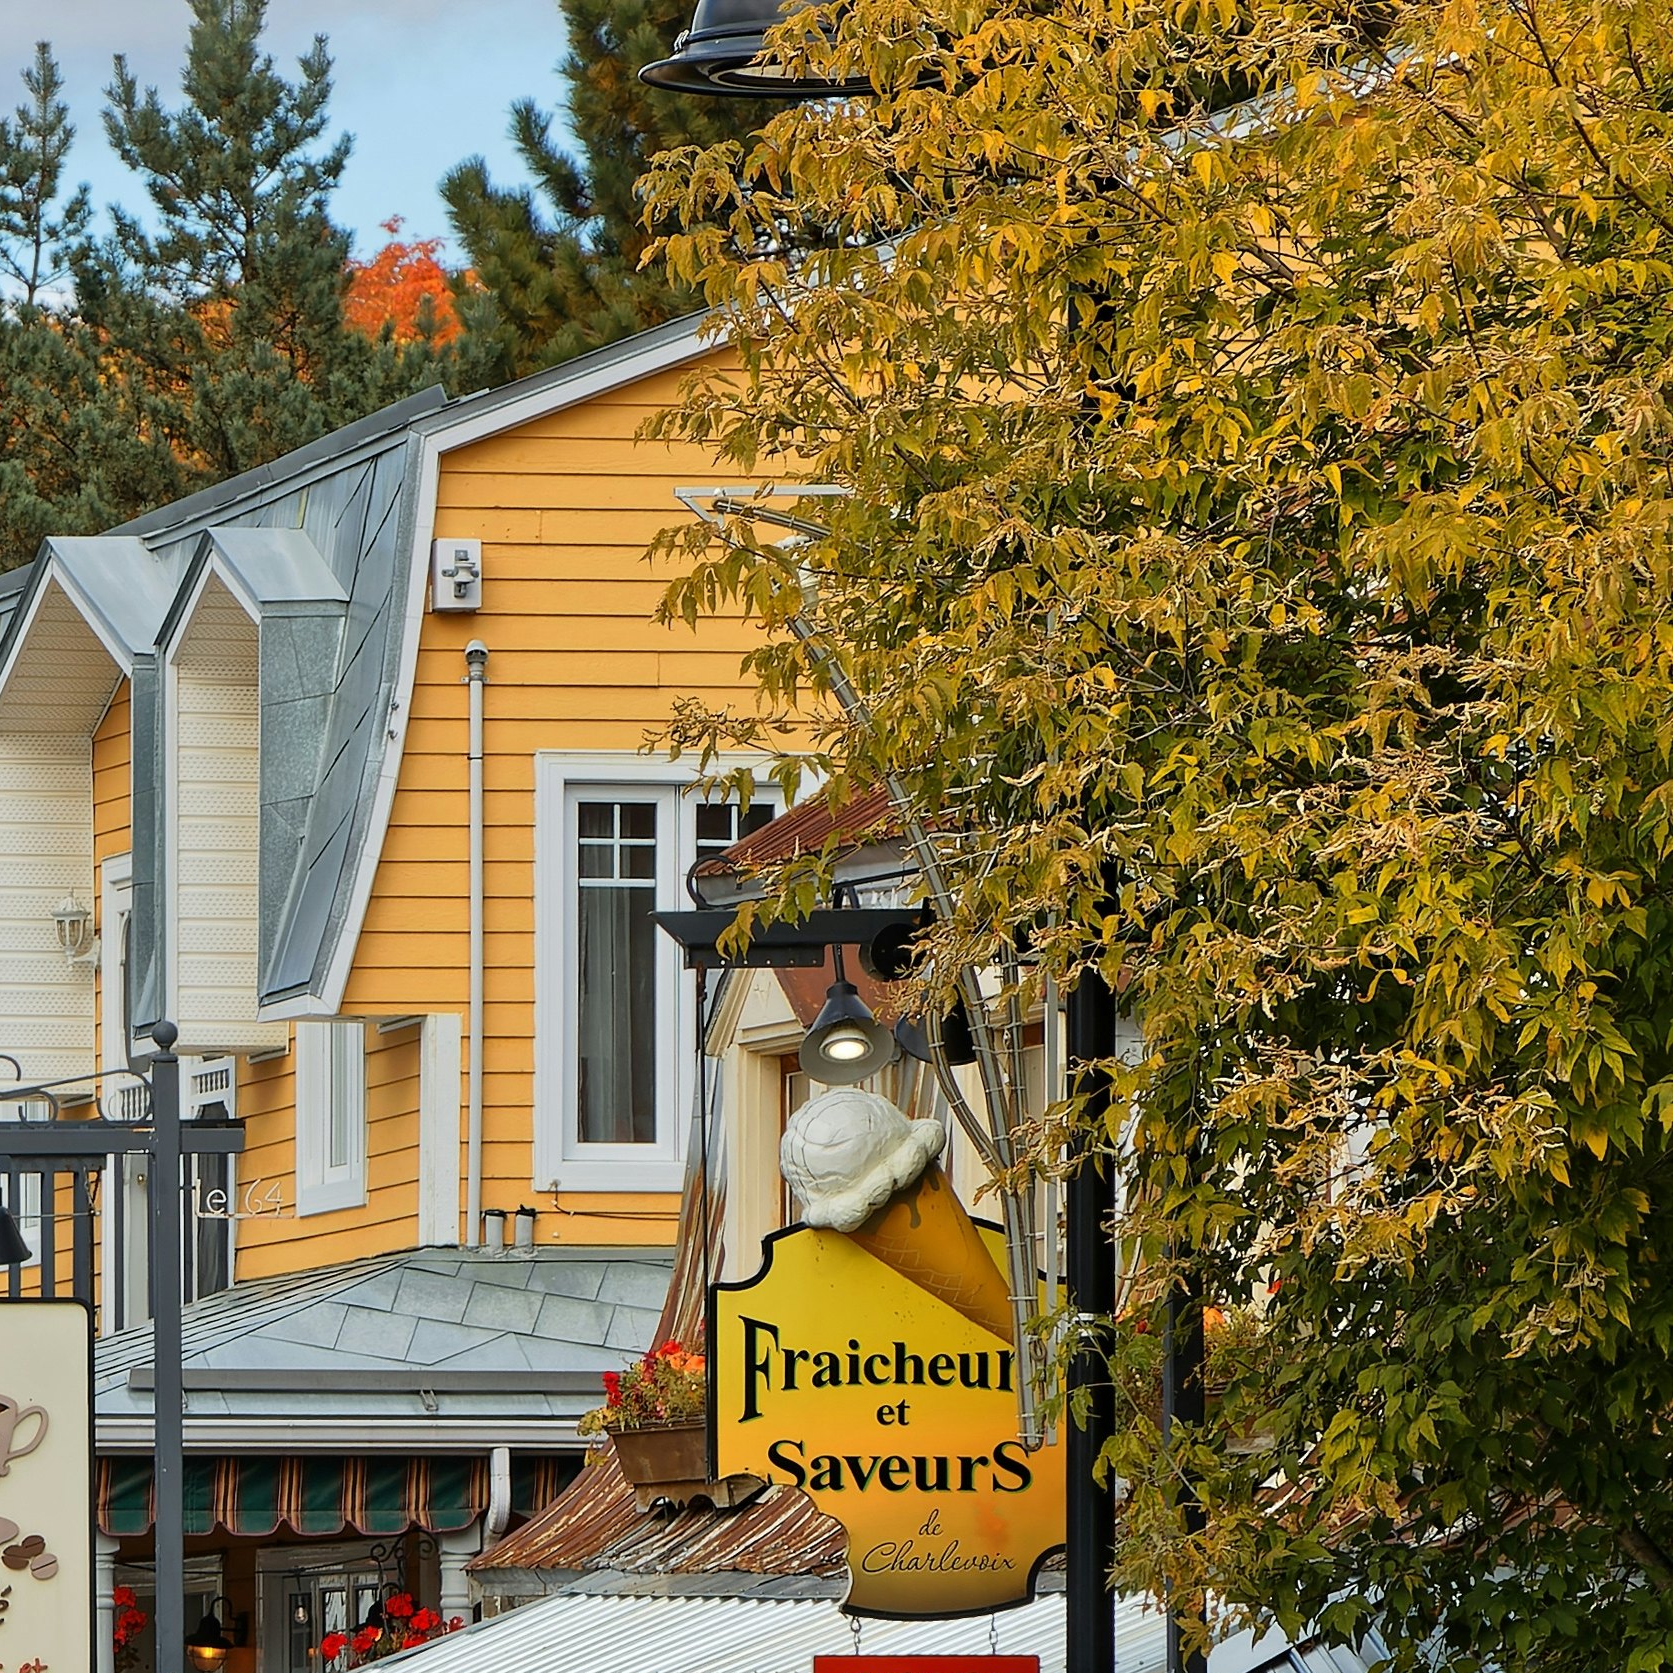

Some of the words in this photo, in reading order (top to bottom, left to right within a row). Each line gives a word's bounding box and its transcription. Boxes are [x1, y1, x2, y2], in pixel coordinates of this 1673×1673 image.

[244, 1178, 283, 1216] 64
[876, 1399, 911, 1426] et
[918, 1508, 944, 1538] de
[861, 1540, 1020, 1574] Charlevoix
